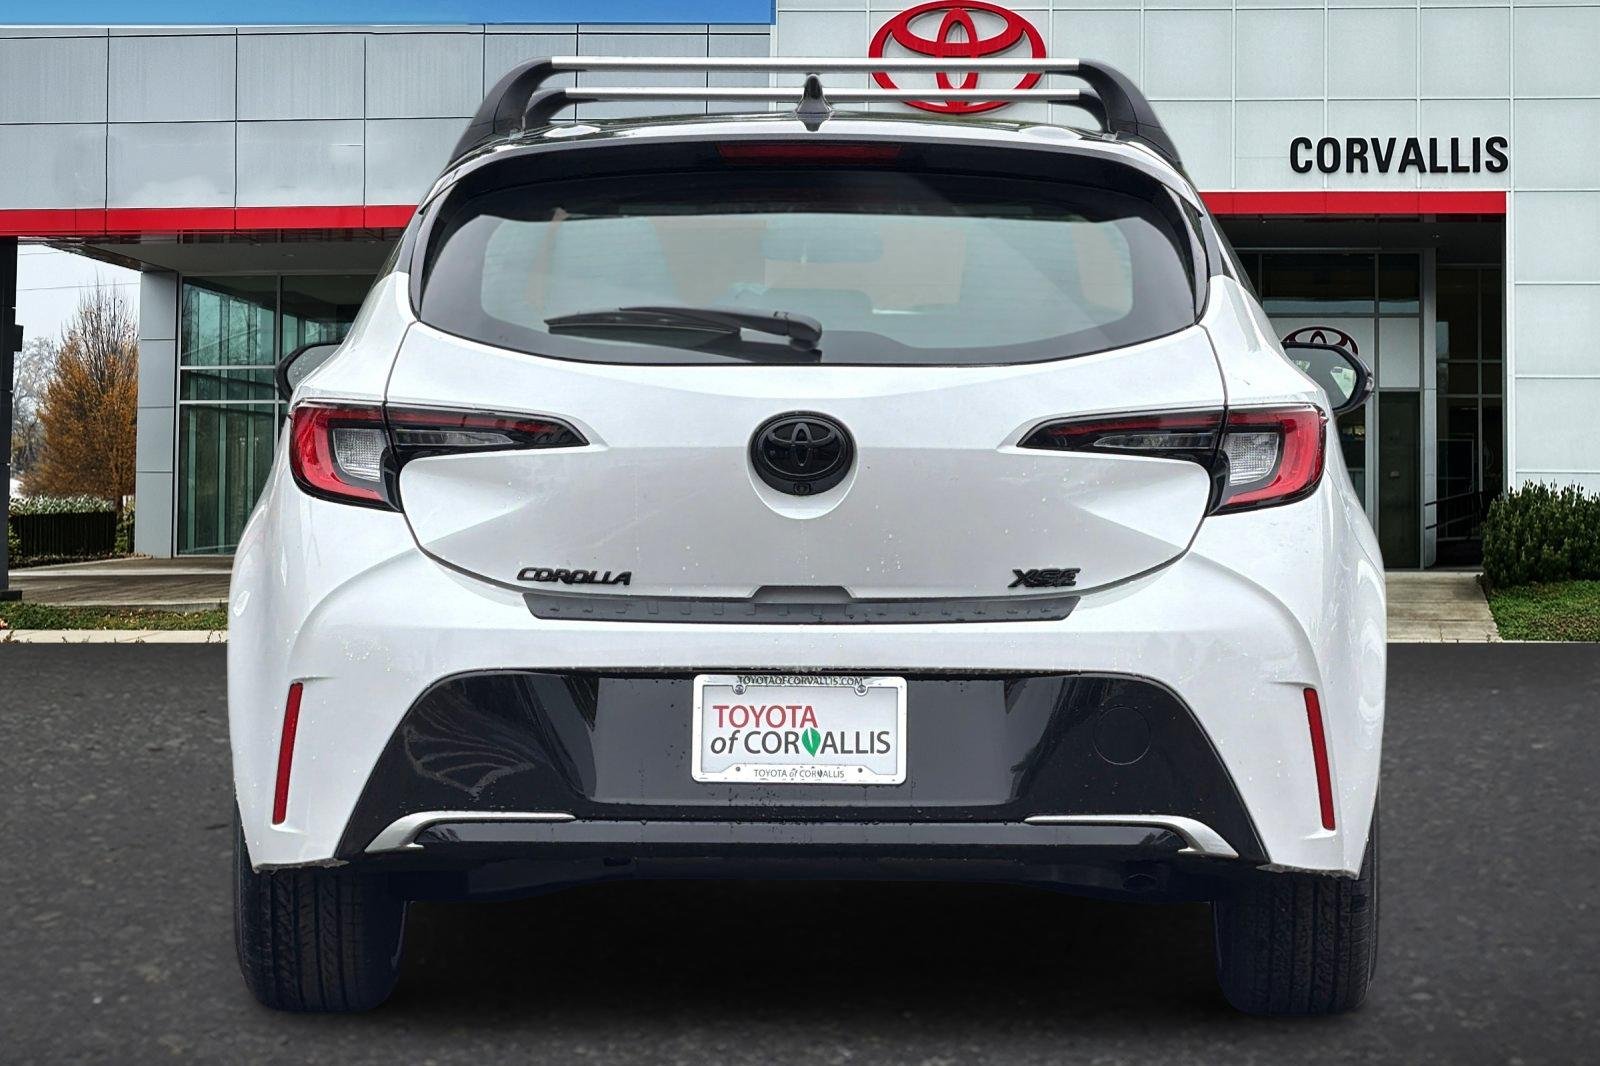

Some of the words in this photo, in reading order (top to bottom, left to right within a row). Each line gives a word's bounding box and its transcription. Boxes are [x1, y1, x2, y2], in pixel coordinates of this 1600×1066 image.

[1290, 136, 1509, 174] CORVALLIS
[517, 567, 632, 585] COROLLA
[737, 675, 863, 686] TOYOTAOFCORVALLIS.COM
[713, 705, 818, 728] TOYOTA
[711, 730, 740, 754] of
[744, 729, 891, 756] CORVALLIS
[754, 769, 787, 778] TOYOTA
[789, 769, 798, 778] of
[800, 769, 845, 779] CORVALLIS
